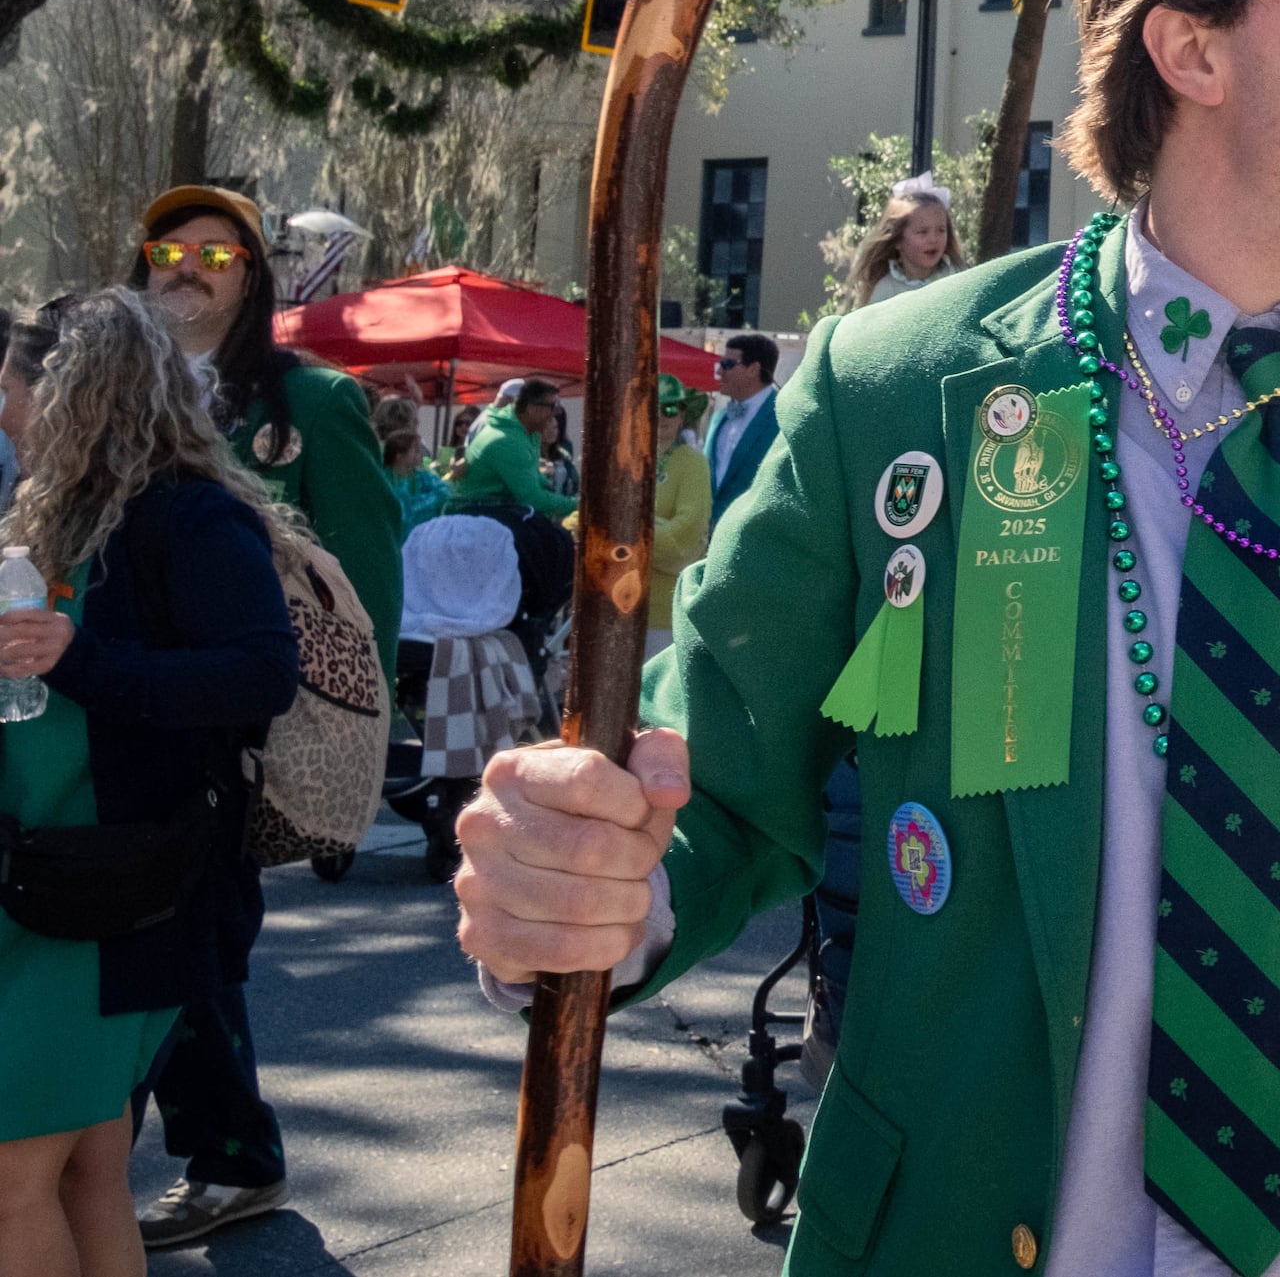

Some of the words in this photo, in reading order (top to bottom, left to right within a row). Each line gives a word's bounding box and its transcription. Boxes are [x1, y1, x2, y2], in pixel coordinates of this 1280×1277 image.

[1043, 490, 1057, 501] GA
[999, 518, 1047, 536] 2025
[975, 546, 1061, 566] PARADE
[1001, 581, 1023, 763] COMMITTEE
